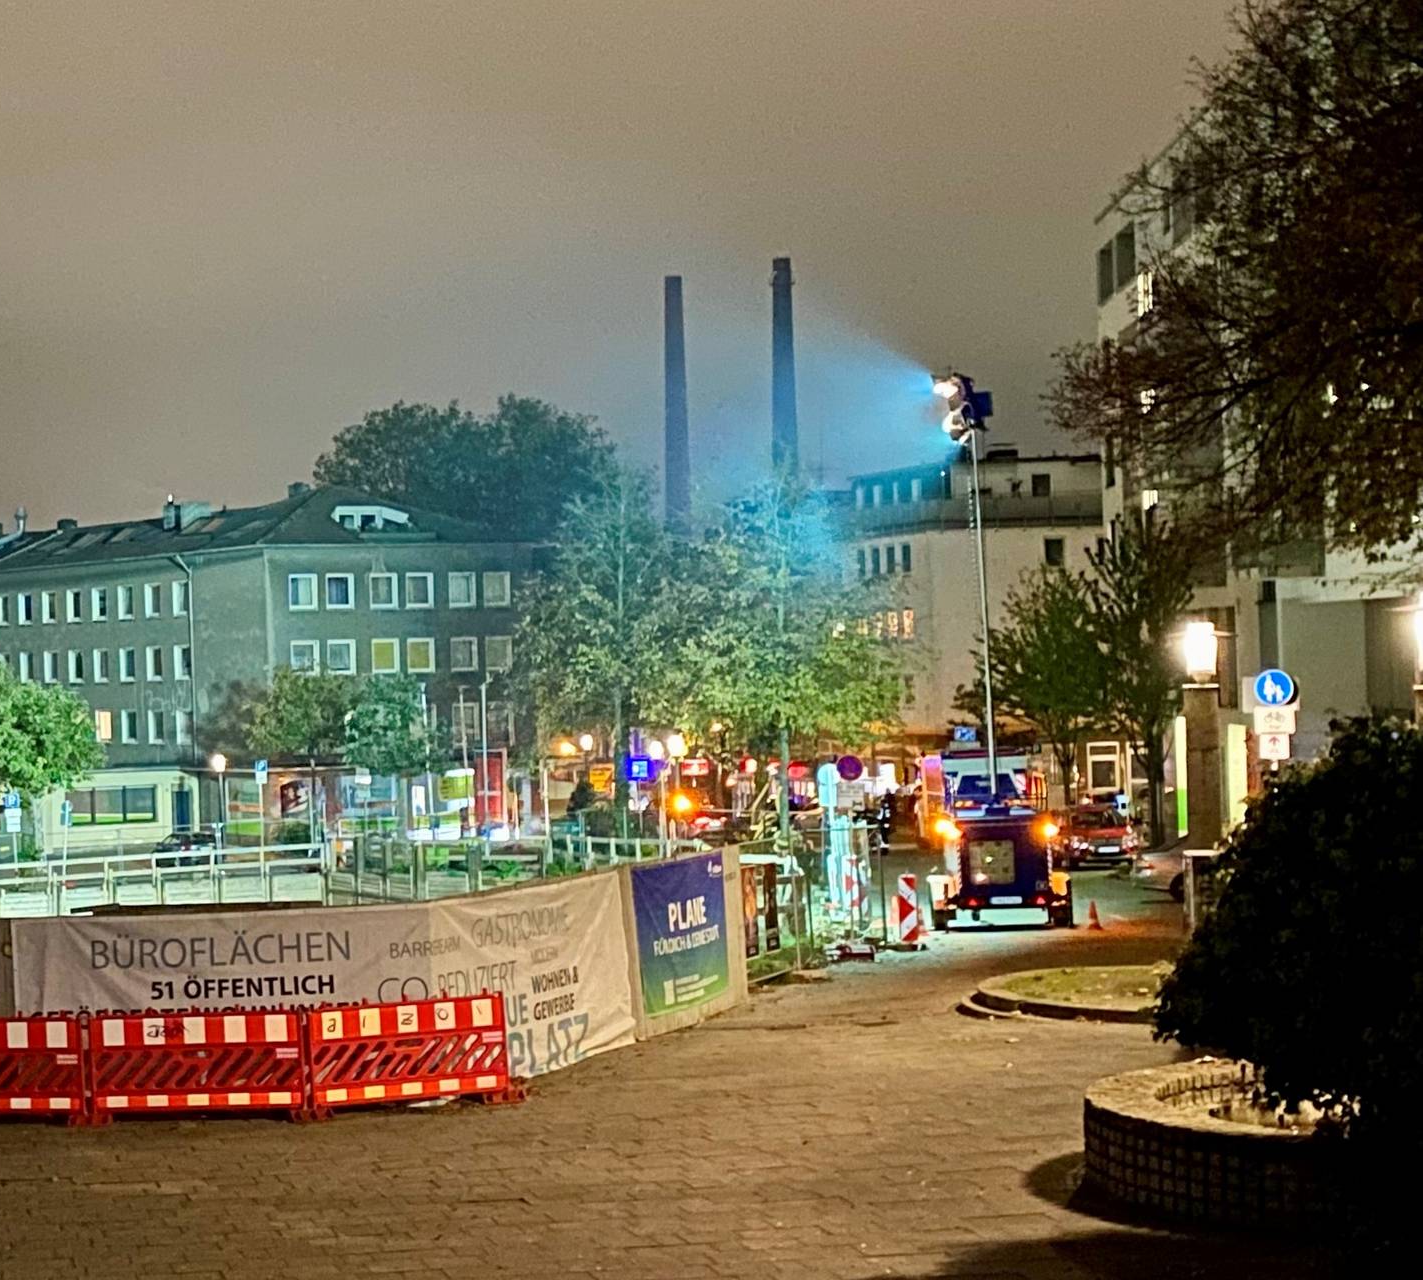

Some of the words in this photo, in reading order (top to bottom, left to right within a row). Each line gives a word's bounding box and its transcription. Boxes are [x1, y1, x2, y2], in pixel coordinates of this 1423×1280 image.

[90, 929, 351, 971] BÜROFLÄCHEN
[150, 981, 175, 1001] 51
[183, 974, 335, 1000] ÖFFENTLICH
